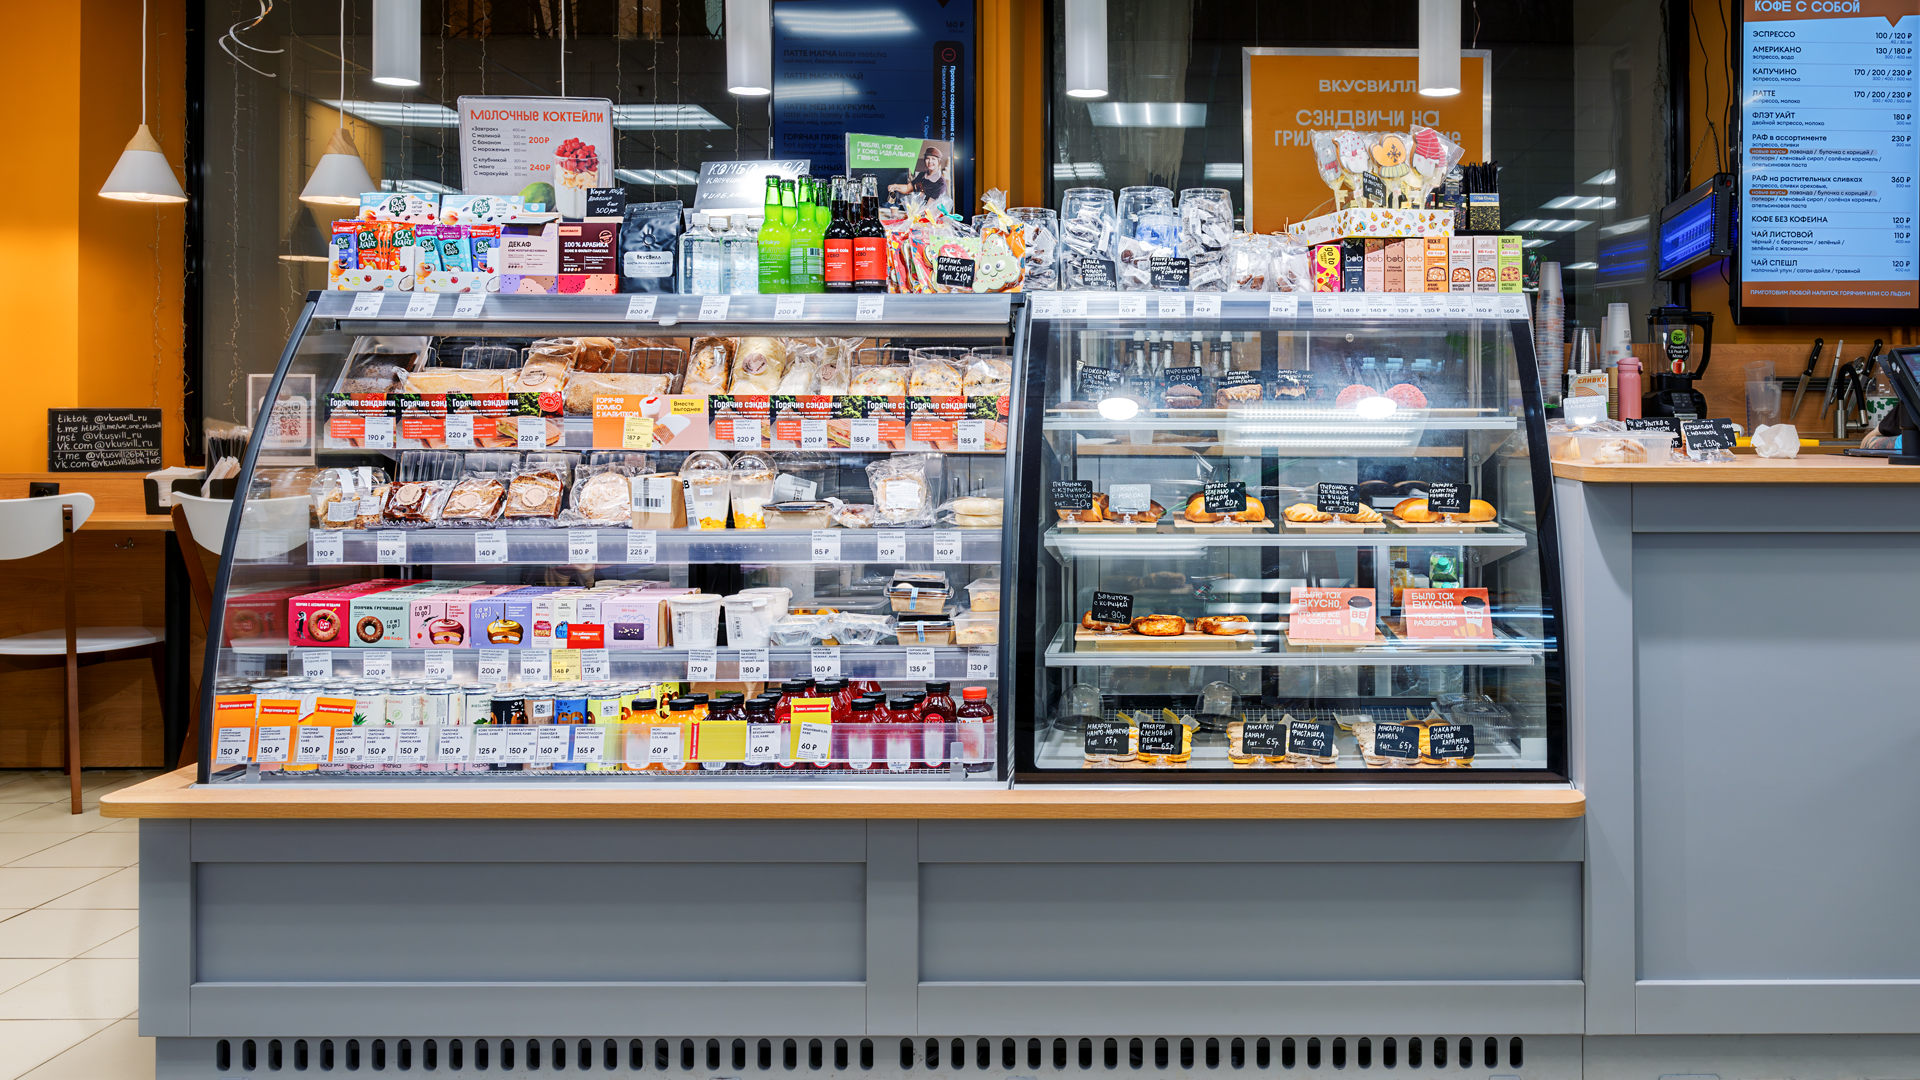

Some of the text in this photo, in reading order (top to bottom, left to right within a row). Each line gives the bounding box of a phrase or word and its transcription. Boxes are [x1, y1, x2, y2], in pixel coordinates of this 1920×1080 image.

[1754, 0, 1860, 13] КОФЕ С СОБОЙ
[1319, 79, 1416, 93] ВКУСВИЛЛ
[543, 110, 604, 123] КОКТЕЙЛИ
[1296, 109, 1405, 128] СЭНДВИЧИ
[1780, 176, 1831, 184] растительных
[1752, 230, 1813, 238] ЧАЙ ЛИСТОВОЙ
[508, 241, 532, 249] ДЕКАФ
[1345, 254, 1363, 262] bob
[1386, 254, 1403, 262] bob
[938, 263, 972, 273] РАСПИСНОЙ
[330, 398, 396, 408] Горячие сэндвичи
[910, 400, 977, 410] Горячие сэндвичи
[57, 414, 88, 423] tiktok
[57, 433, 76, 442] inst
[1298, 591, 1322, 599] БЫЛО
[1297, 618, 1341, 626] РАЗОБРАЛИ
[1292, 722, 1320, 731] МАКАРОН
[1378, 725, 1404, 733] МАКАРОН
[1433, 725, 1461, 733] МАКАРОН
